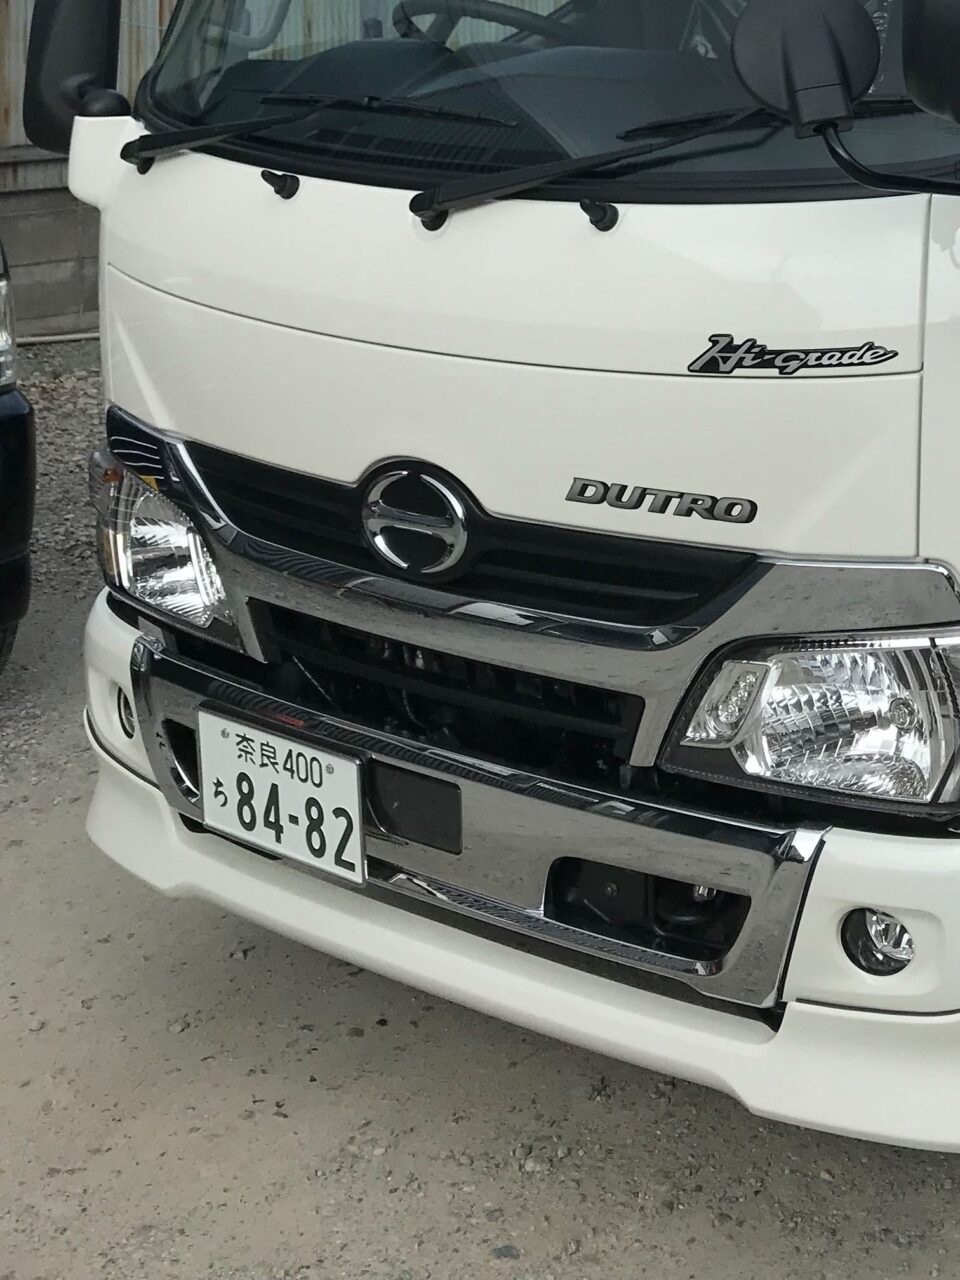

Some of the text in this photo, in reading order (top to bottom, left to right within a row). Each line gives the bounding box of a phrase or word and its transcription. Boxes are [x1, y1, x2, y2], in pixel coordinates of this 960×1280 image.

[688, 334, 899, 375] Hi-grade
[565, 477, 758, 523] DUTRO
[212, 772, 356, 872] ち 84-82
